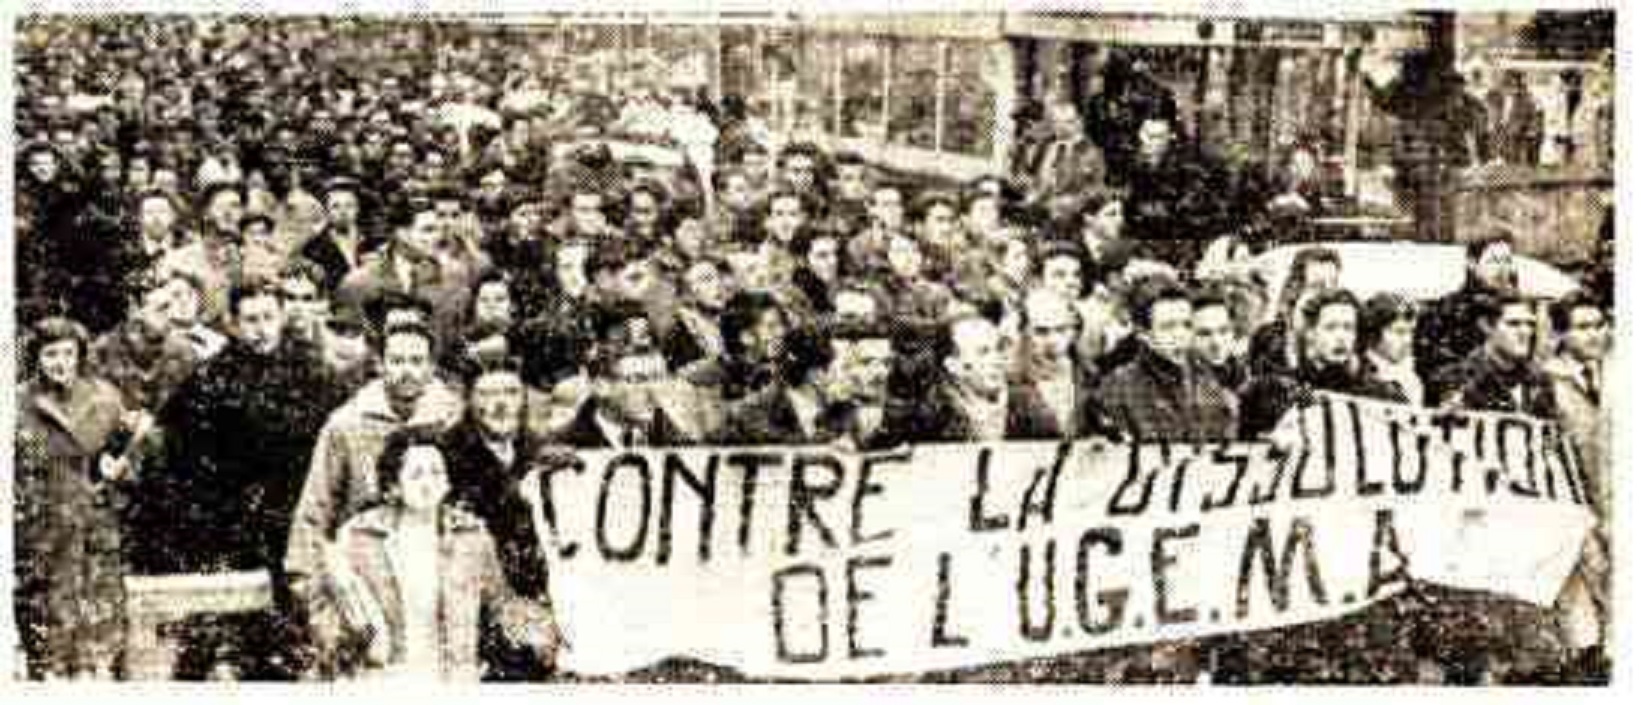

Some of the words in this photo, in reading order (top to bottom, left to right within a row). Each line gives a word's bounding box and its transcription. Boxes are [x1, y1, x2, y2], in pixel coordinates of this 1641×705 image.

[537, 443, 912, 564] CONTRE
[970, 439, 1072, 532] LA
[771, 556, 892, 664] DE
